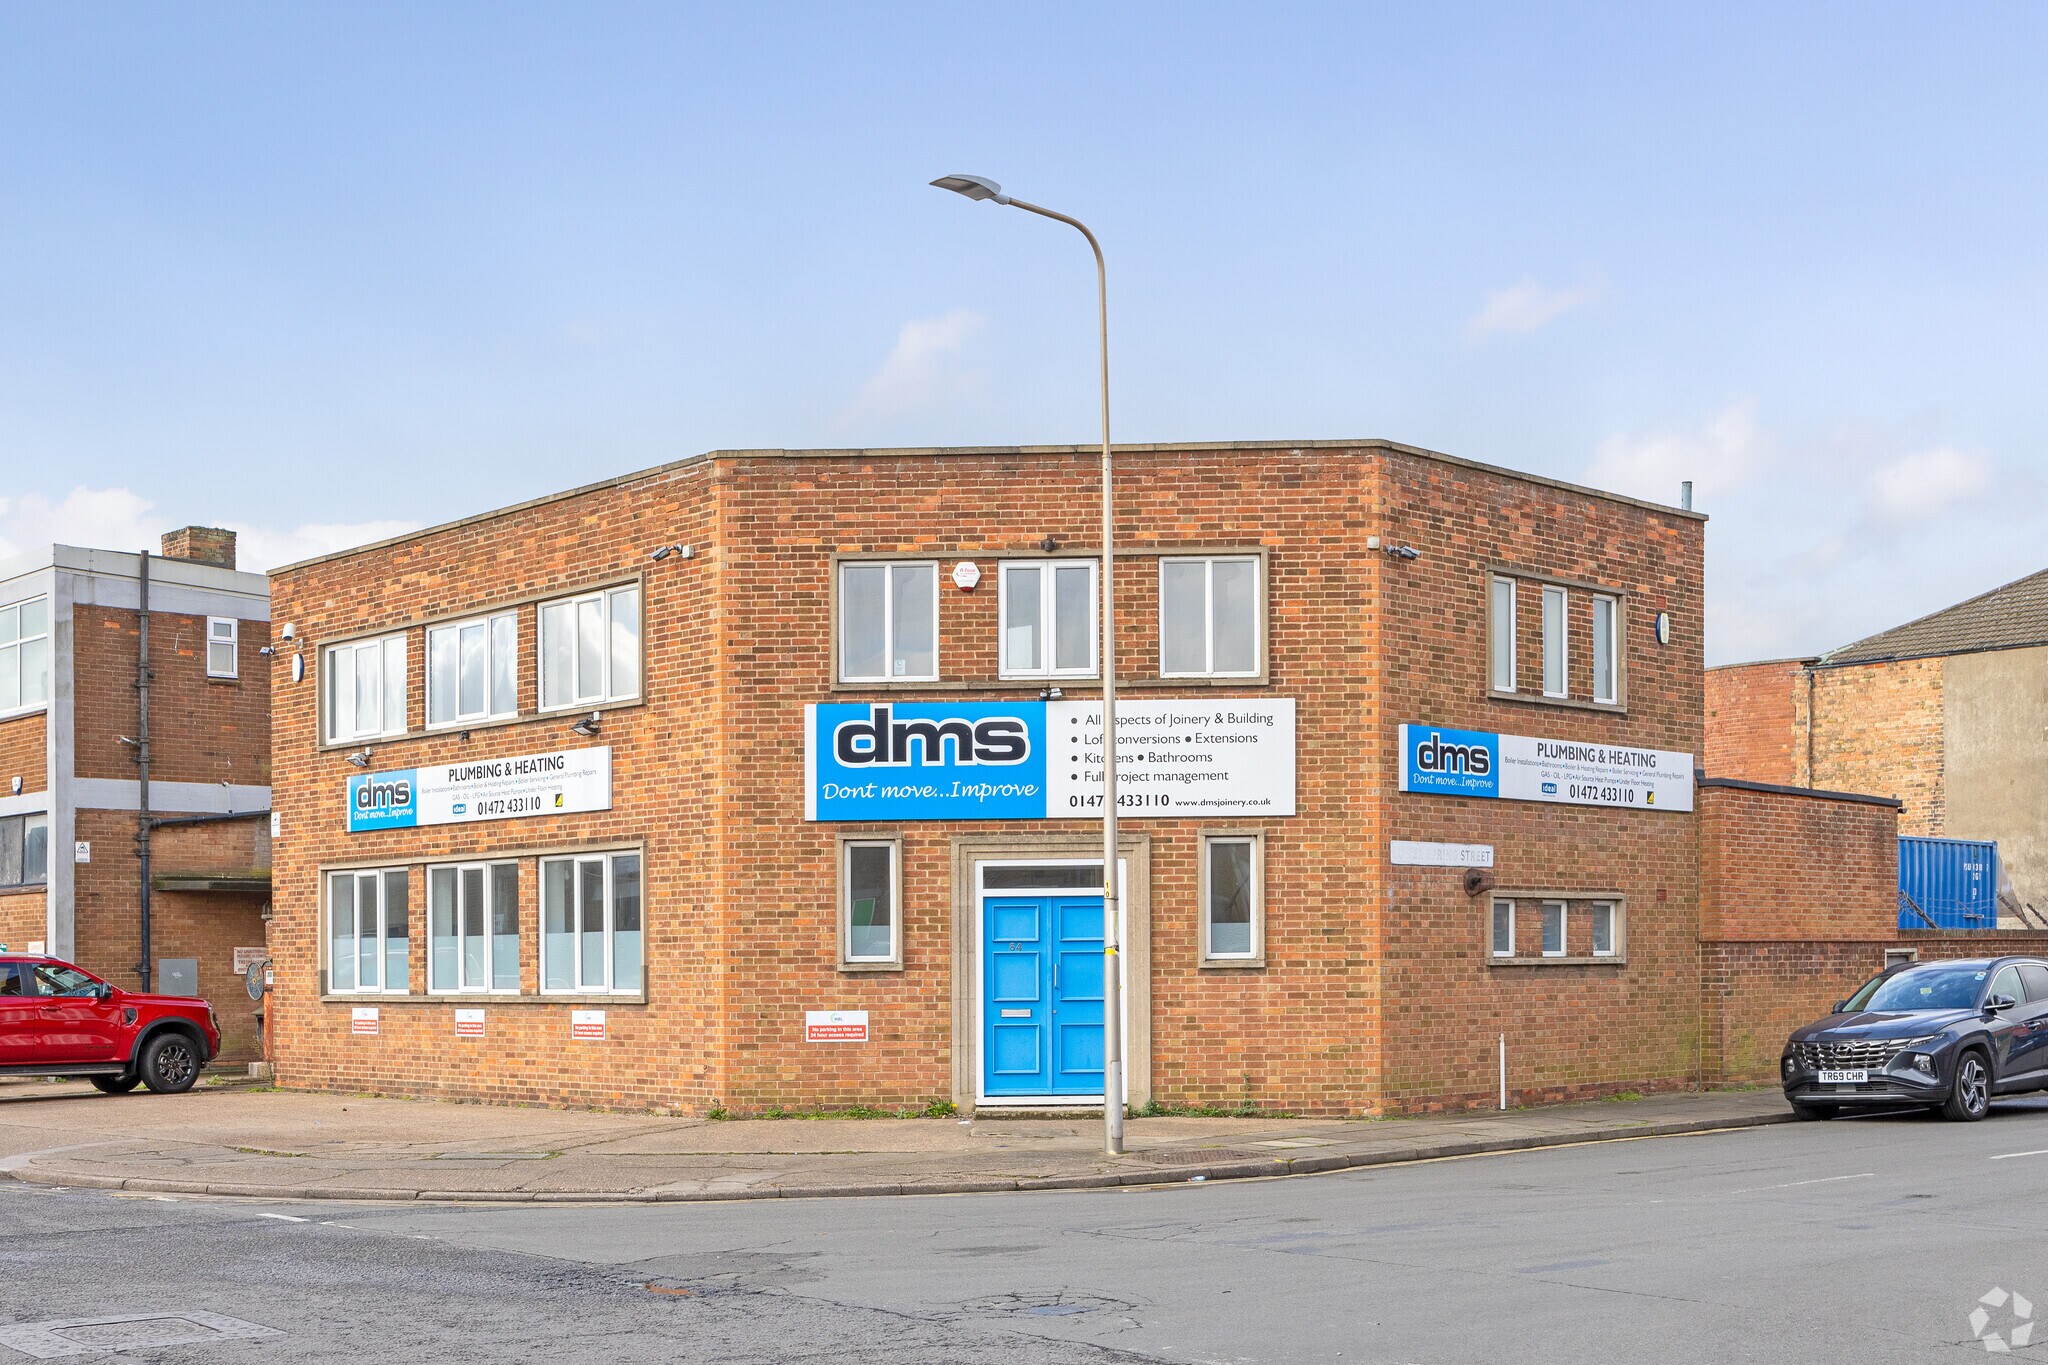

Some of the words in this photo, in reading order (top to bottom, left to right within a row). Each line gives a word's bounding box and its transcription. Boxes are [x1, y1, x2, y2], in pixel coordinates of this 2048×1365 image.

[1086, 714, 1100, 726] All
[1114, 715, 1150, 728] spects
[1154, 714, 1167, 725] of
[1169, 713, 1211, 728] Joinery
[1214, 713, 1224, 724] &
[1228, 713, 1274, 726] Building
[838, 708, 1026, 764] dms
[1084, 734, 1104, 744] Lof
[1115, 733, 1180, 744] onversions
[1195, 732, 1258, 744] Extensions
[1084, 752, 1134, 763] Kitcens
[1148, 752, 1213, 763] Bathrooms
[1418, 734, 1489, 774] dms
[1538, 742, 1595, 762] PLUMBING
[1598, 750, 1606, 764] &
[1609, 750, 1656, 768] HEATING
[448, 763, 502, 782] PLUMBING
[505, 762, 512, 776] &
[514, 755, 564, 775] HEATING
[1084, 770, 1104, 782] Full
[1116, 771, 1150, 784] roject
[1154, 771, 1229, 784] management
[1413, 773, 1435, 784] Dont
[358, 778, 409, 808] dms
[822, 782, 878, 800] Dont
[1570, 784, 1598, 800] 01472
[1601, 787, 1634, 803] 433110
[478, 800, 504, 815] 01472
[507, 796, 540, 812] 433110
[1069, 795, 1104, 807] 0147
[1117, 795, 1169, 806] 433110
[1175, 798, 1271, 808] www.dmsjoinery.co.uk
[354, 811, 370, 820] Dont
[1460, 850, 1490, 861] STREET
[1822, 1072, 1844, 1080] TR69
[1846, 1072, 1864, 1080] CHR
